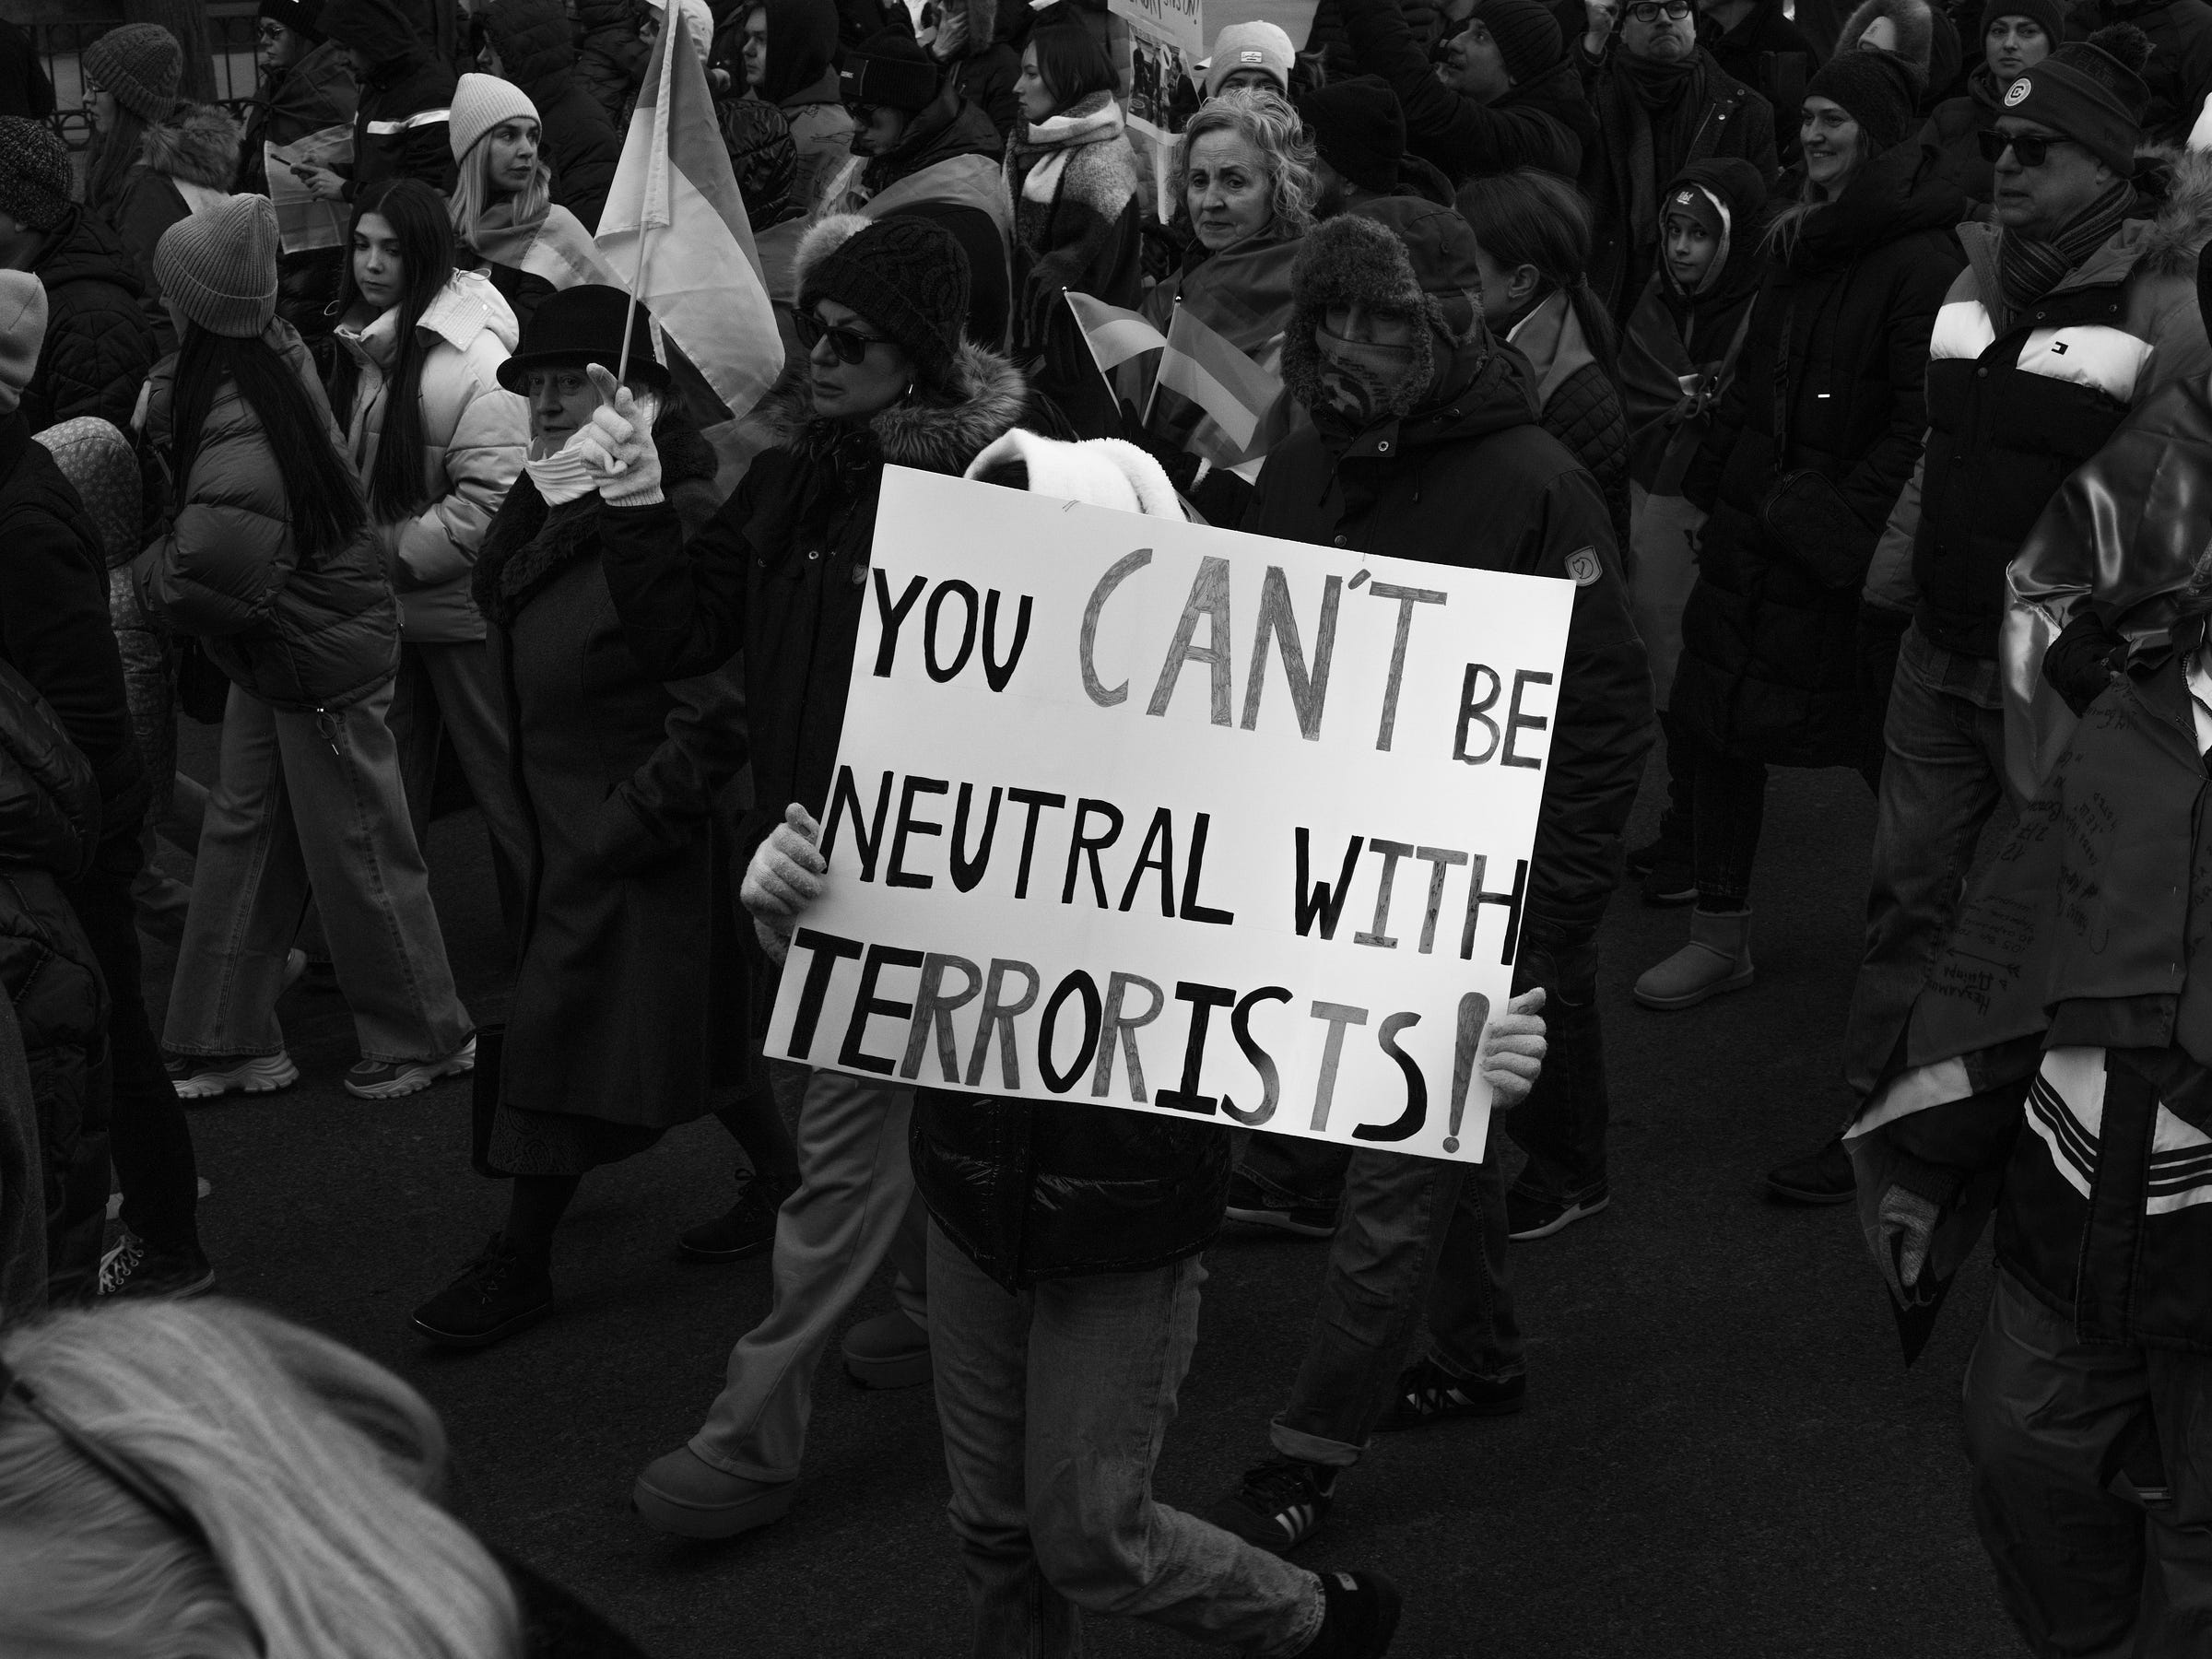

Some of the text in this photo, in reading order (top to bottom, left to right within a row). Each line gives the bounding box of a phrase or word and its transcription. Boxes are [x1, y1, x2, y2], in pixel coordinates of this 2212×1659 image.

[872, 547, 1554, 770] YOU CAN'T BE
[820, 764, 1528, 966] NEUTRAL WITH
[786, 927, 1491, 1155] TERRORISTS!
